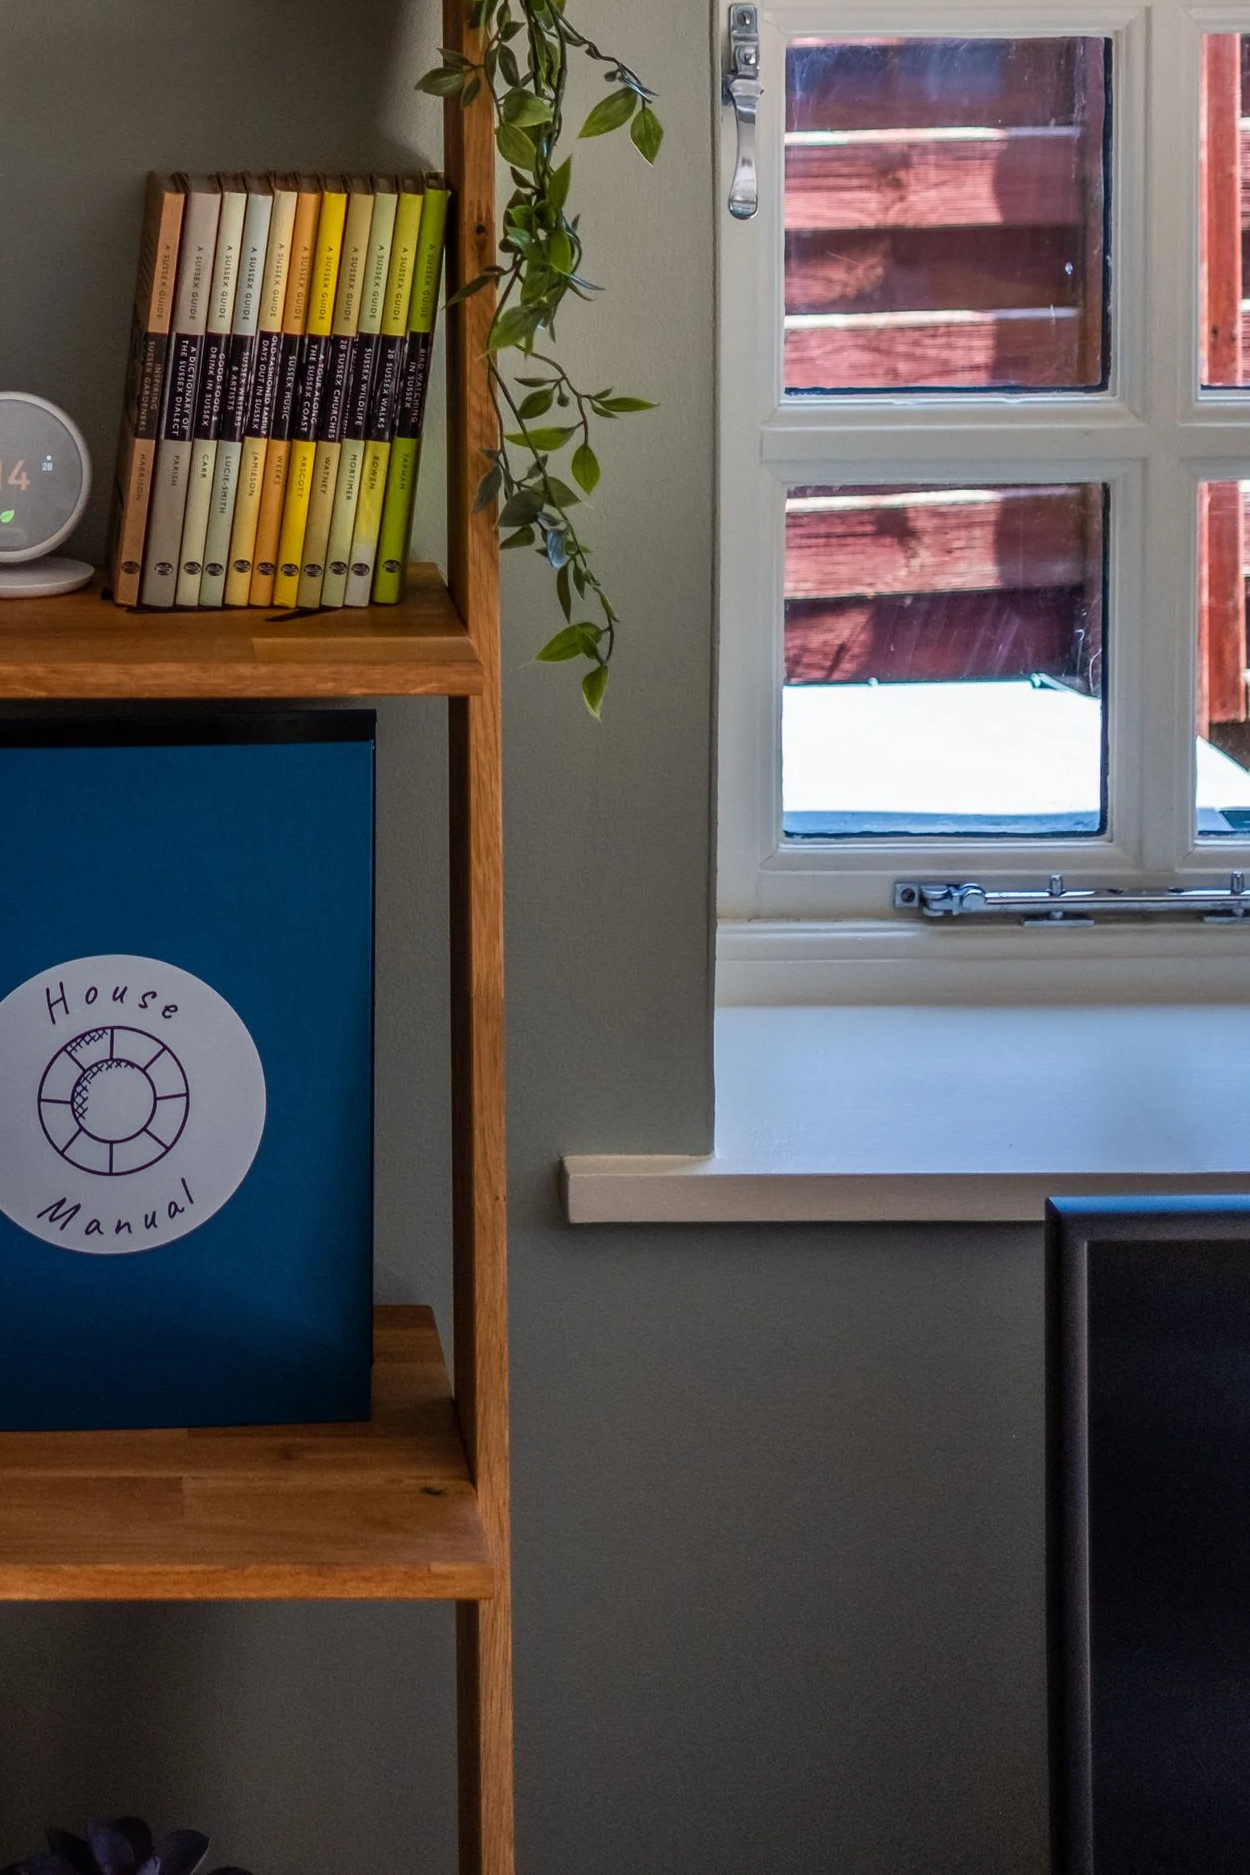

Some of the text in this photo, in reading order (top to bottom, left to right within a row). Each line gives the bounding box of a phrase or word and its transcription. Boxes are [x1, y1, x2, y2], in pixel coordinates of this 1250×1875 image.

[161, 255, 170, 286] SUSSEX
[193, 256, 203, 288] SUSSEX
[224, 256, 232, 287] SUSSEX
[247, 257, 256, 289] SUSSEX
[274, 253, 284, 286] SUSSEX
[299, 256, 308, 288] SUSSEX
[323, 257, 333, 288] SUSSEX
[349, 257, 358, 289] SUSSEX
[374, 255, 384, 287] SUSSEX
[398, 257, 407, 289] SUSSEX
[424, 253, 434, 286] SUSSEX
[157, 290, 166, 319] GUIDE
[190, 292, 198, 320] GUIDE
[219, 291, 228, 319] GUIDE
[243, 292, 252, 321] GUIDE
[270, 289, 279, 317] GUIDE
[294, 292, 303, 320] GUIDE
[319, 292, 328, 320] GUIDE
[344, 292, 353, 321] GUIDE
[370, 291, 379, 318] GUIDE
[393, 292, 402, 321] GUIDE
[421, 289, 429, 317] GUIDE
[217, 353, 225, 381] GOOD
[315, 364, 323, 388] TOUR
[139, 341, 155, 431] SUSSEX GARDENERS
[151, 364, 162, 410] INSPIRING
[172, 340, 189, 436] THE SUSSEX DIALECT
[183, 356, 196, 414] DICTIONARY
[202, 347, 217, 427] DRINK IN SUSSEX
[213, 386, 221, 412] FOOD
[227, 375, 237, 410] ARTISTS
[235, 352, 249, 427] SUSSEX WRITERS
[252, 340, 269, 429] DAYS OUT IN SUSSEX
[282, 356, 296, 420] SUSSEX MUSIC
[301, 344, 317, 432] THE SUSSEX COAST
[329, 340, 347, 439] 20 SUSSEX CHURCHES
[355, 348, 372, 426] SUSSEX WILDLIFE
[378, 349, 395, 429] 20 SUSSEX WALKS
[405, 362, 416, 408] IN SUSSEX
[411, 374, 423, 423] WATCHING
[261, 407, 270, 435] FAMILY
[311, 391, 320, 424] ALONG
[181, 418, 189, 430] OF
[136, 453, 147, 501] HARRISON
[172, 455, 181, 486] PARISH
[201, 454, 209, 478] CARR
[248, 451, 259, 497] JAMIESON
[274, 455, 284, 485] WEEKS
[298, 456, 307, 498] ARSCOTT
[320, 457, 331, 494] WATNEY
[346, 454, 358, 501] MORTIMER
[370, 456, 379, 490] BOWEN
[219, 456, 232, 514] LUCIE-SMITH
[46, 981, 178, 1025] House
[37, 1177, 194, 1236] Manual
